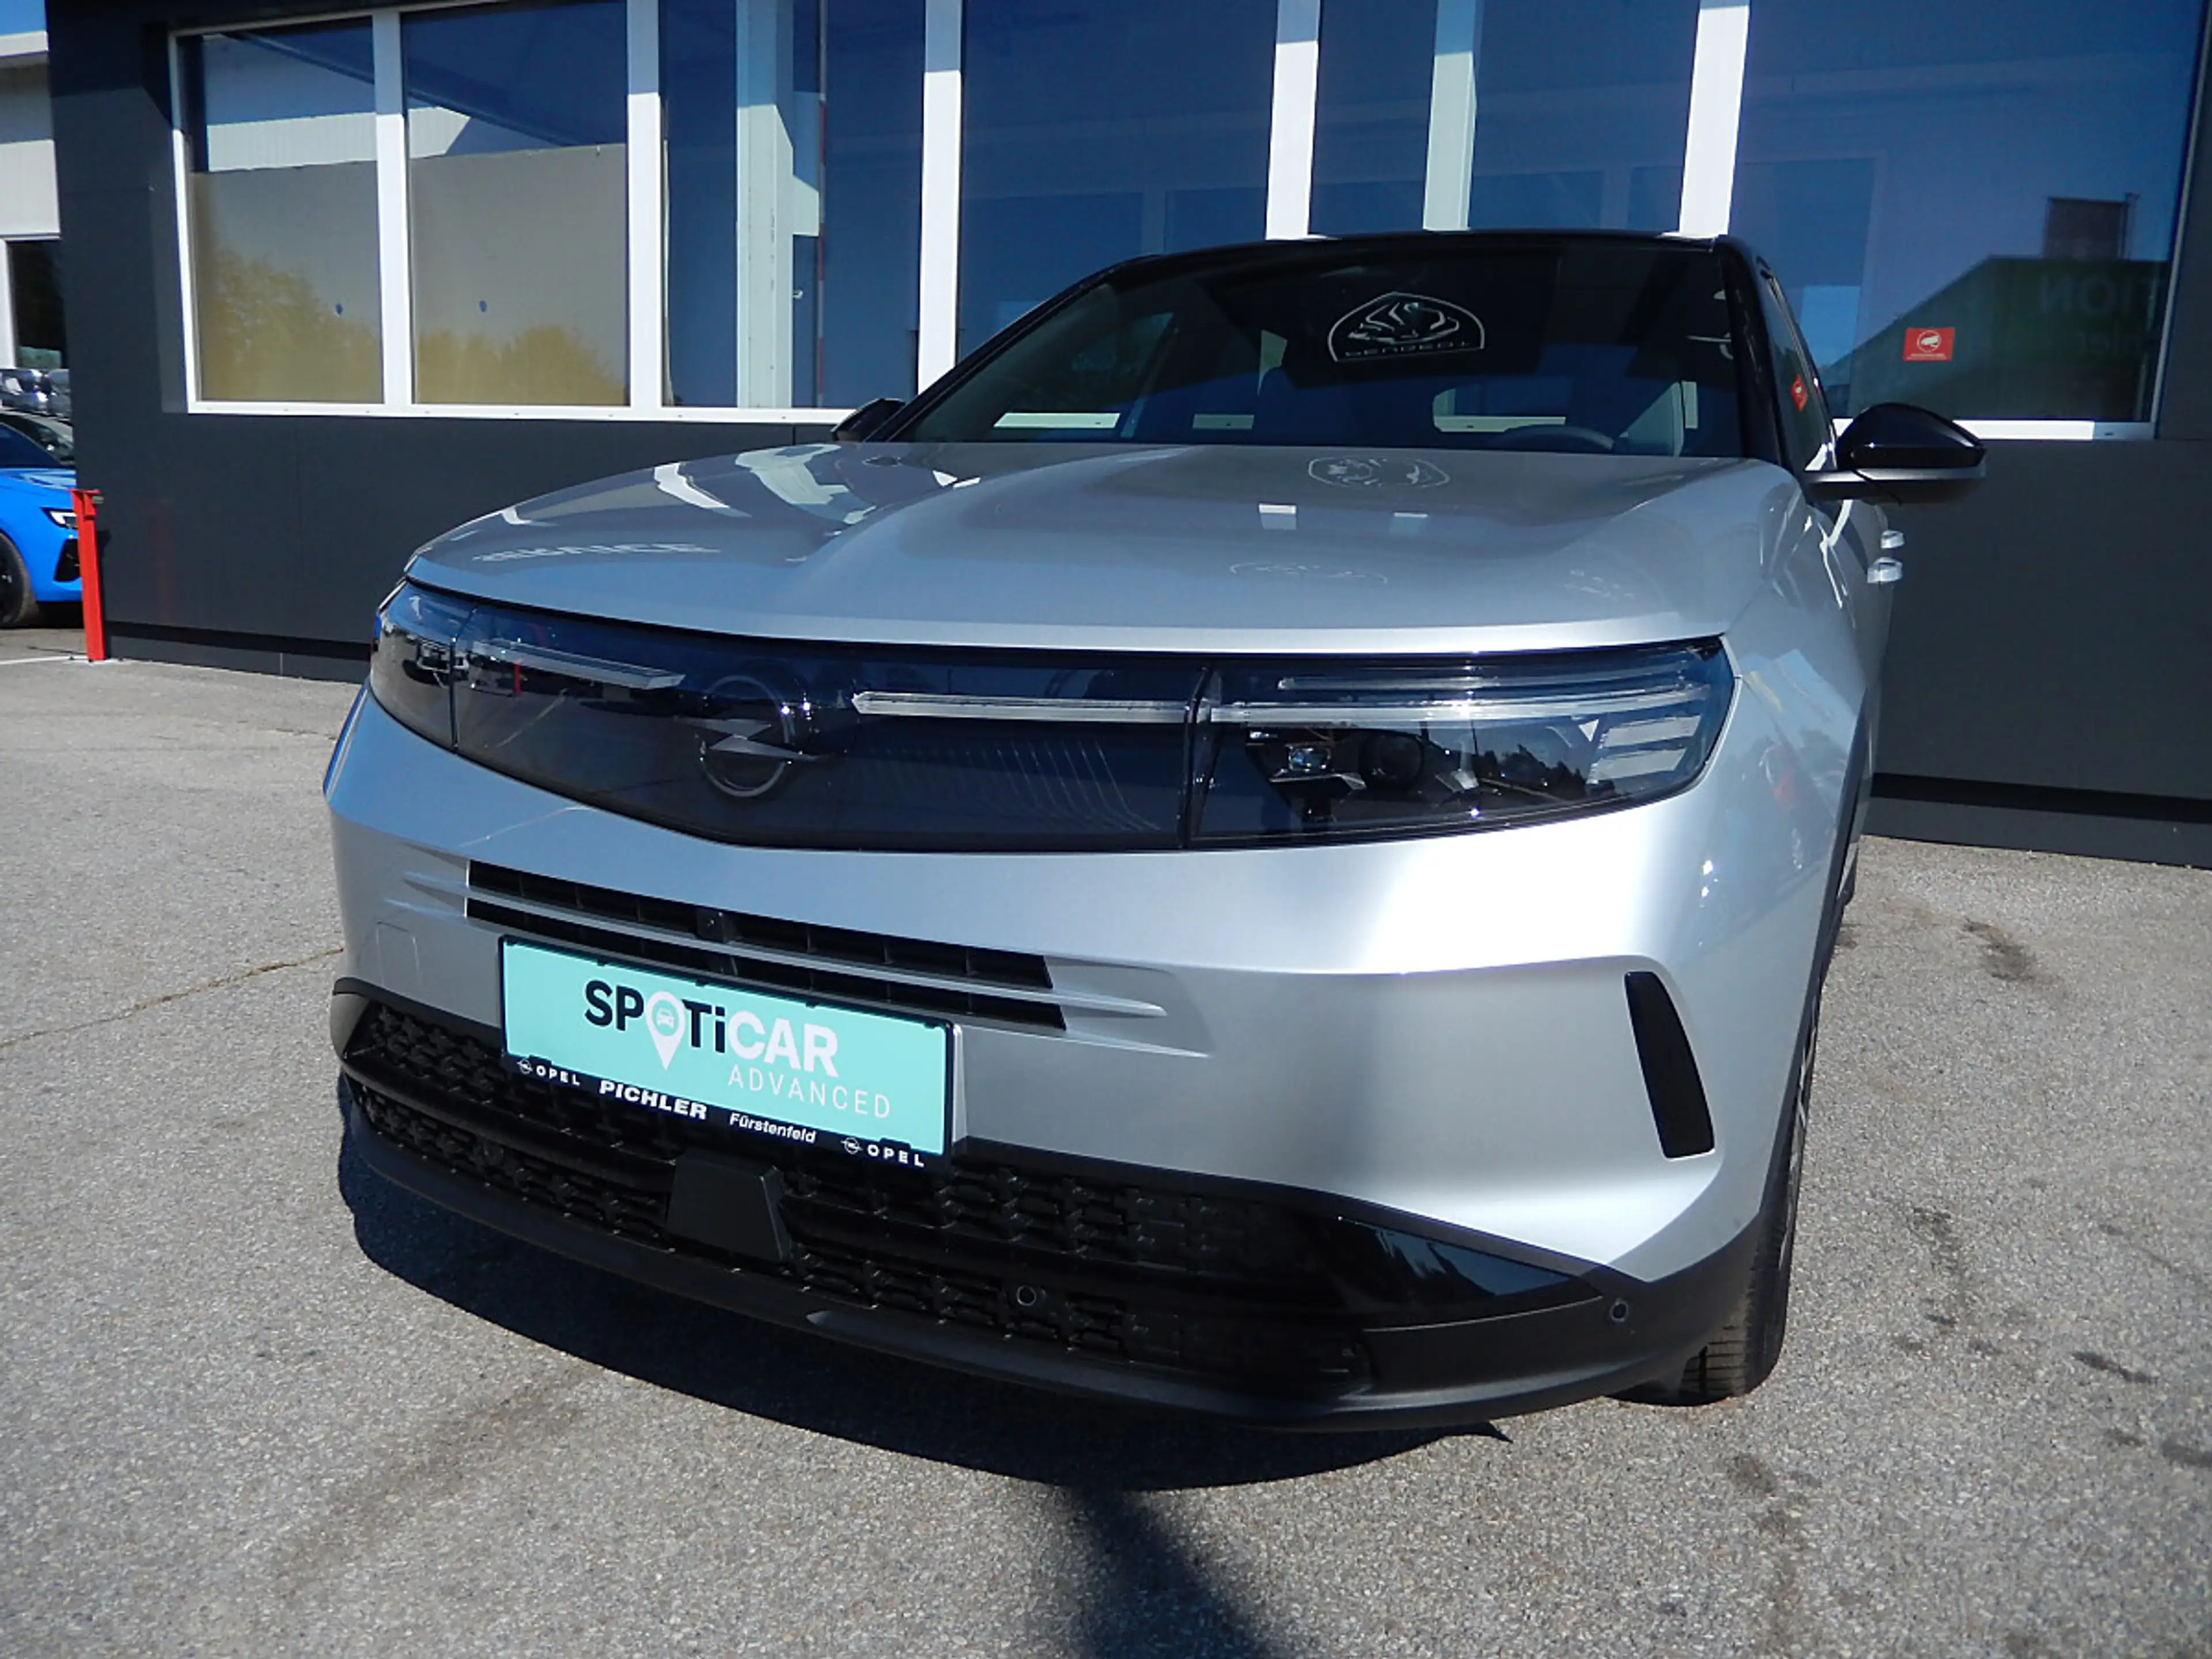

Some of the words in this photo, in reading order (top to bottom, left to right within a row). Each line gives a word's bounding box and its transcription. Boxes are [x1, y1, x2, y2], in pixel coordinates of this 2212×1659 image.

[536, 1065, 581, 1086] OPEL
[599, 1080, 708, 1120] PICHLER
[729, 1112, 817, 1144] Fürstenfeld
[867, 1144, 925, 1168] OPEL
[728, 1065, 891, 1118] ADVANCED
